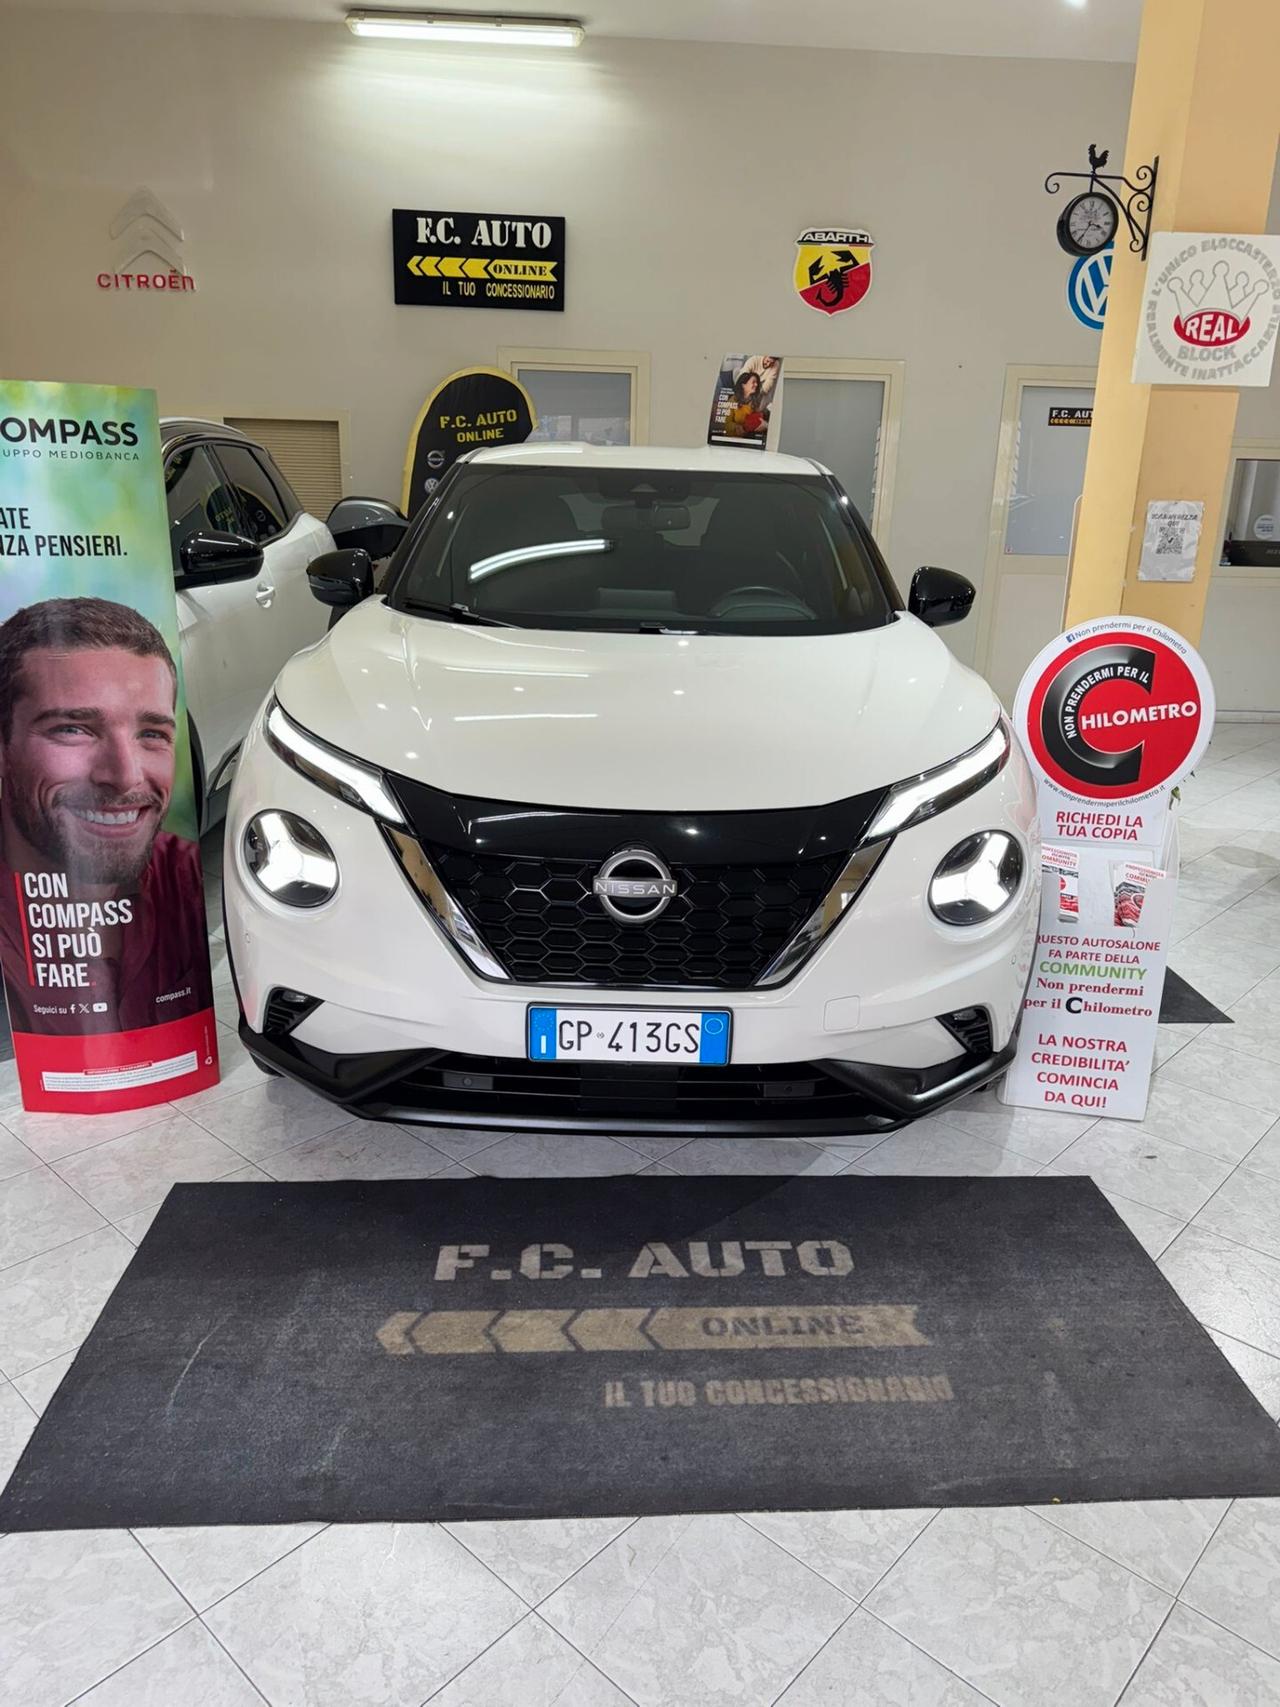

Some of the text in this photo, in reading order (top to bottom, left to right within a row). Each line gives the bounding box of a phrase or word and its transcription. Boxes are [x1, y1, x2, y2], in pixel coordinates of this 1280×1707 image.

[416, 217, 552, 248] F.C. AUTO
[803, 232, 868, 243] ABARTH
[493, 263, 547, 277] ONLINE
[442, 281, 555, 300] IL TUO CONCESSIONARIO
[1185, 313, 1238, 342] REAL
[1177, 345, 1237, 362] BLOCK
[440, 409, 518, 429] F.C. AUTO
[0, 416, 139, 447] OMPASS
[457, 428, 504, 442] ONLINE
[2, 449, 140, 461] UPPO MEDIOBANCA
[35, 534, 128, 557] PENSIERI.
[1075, 628, 1091, 640] Non
[1092, 621, 1132, 635] prendermi
[1133, 622, 1146, 634] per
[1152, 627, 1187, 655] Chilometro
[1063, 665, 1150, 739] NON PRENDERMI PER IL
[1056, 811, 1143, 828] RICHIEDI LA
[1057, 824, 1138, 841] TUA COPIA
[24, 872, 69, 898] CON
[595, 881, 675, 895] NISSAN
[28, 899, 133, 928] COMPASS
[32, 927, 102, 958] SI PUÒ
[1081, 936, 1161, 951] AUTOSALONE
[1048, 949, 1140, 964] FA PARTE DELLA
[1040, 961, 1147, 980] COMMUNITY
[155, 986, 192, 1004] compass.it
[1036, 977, 1144, 997] Non prendermi
[33, 1003, 67, 1015] Seguici su
[1024, 997, 1047, 1010] per
[1051, 998, 1061, 1009] il
[1038, 1033, 1127, 1053] LA NOSTRA
[1037, 1071, 1119, 1091] COMINCIA
[1044, 1091, 1107, 1109] DA QUI!
[434, 1240, 855, 1281] F.C. AUTO
[702, 1311, 865, 1339] ONLINE
